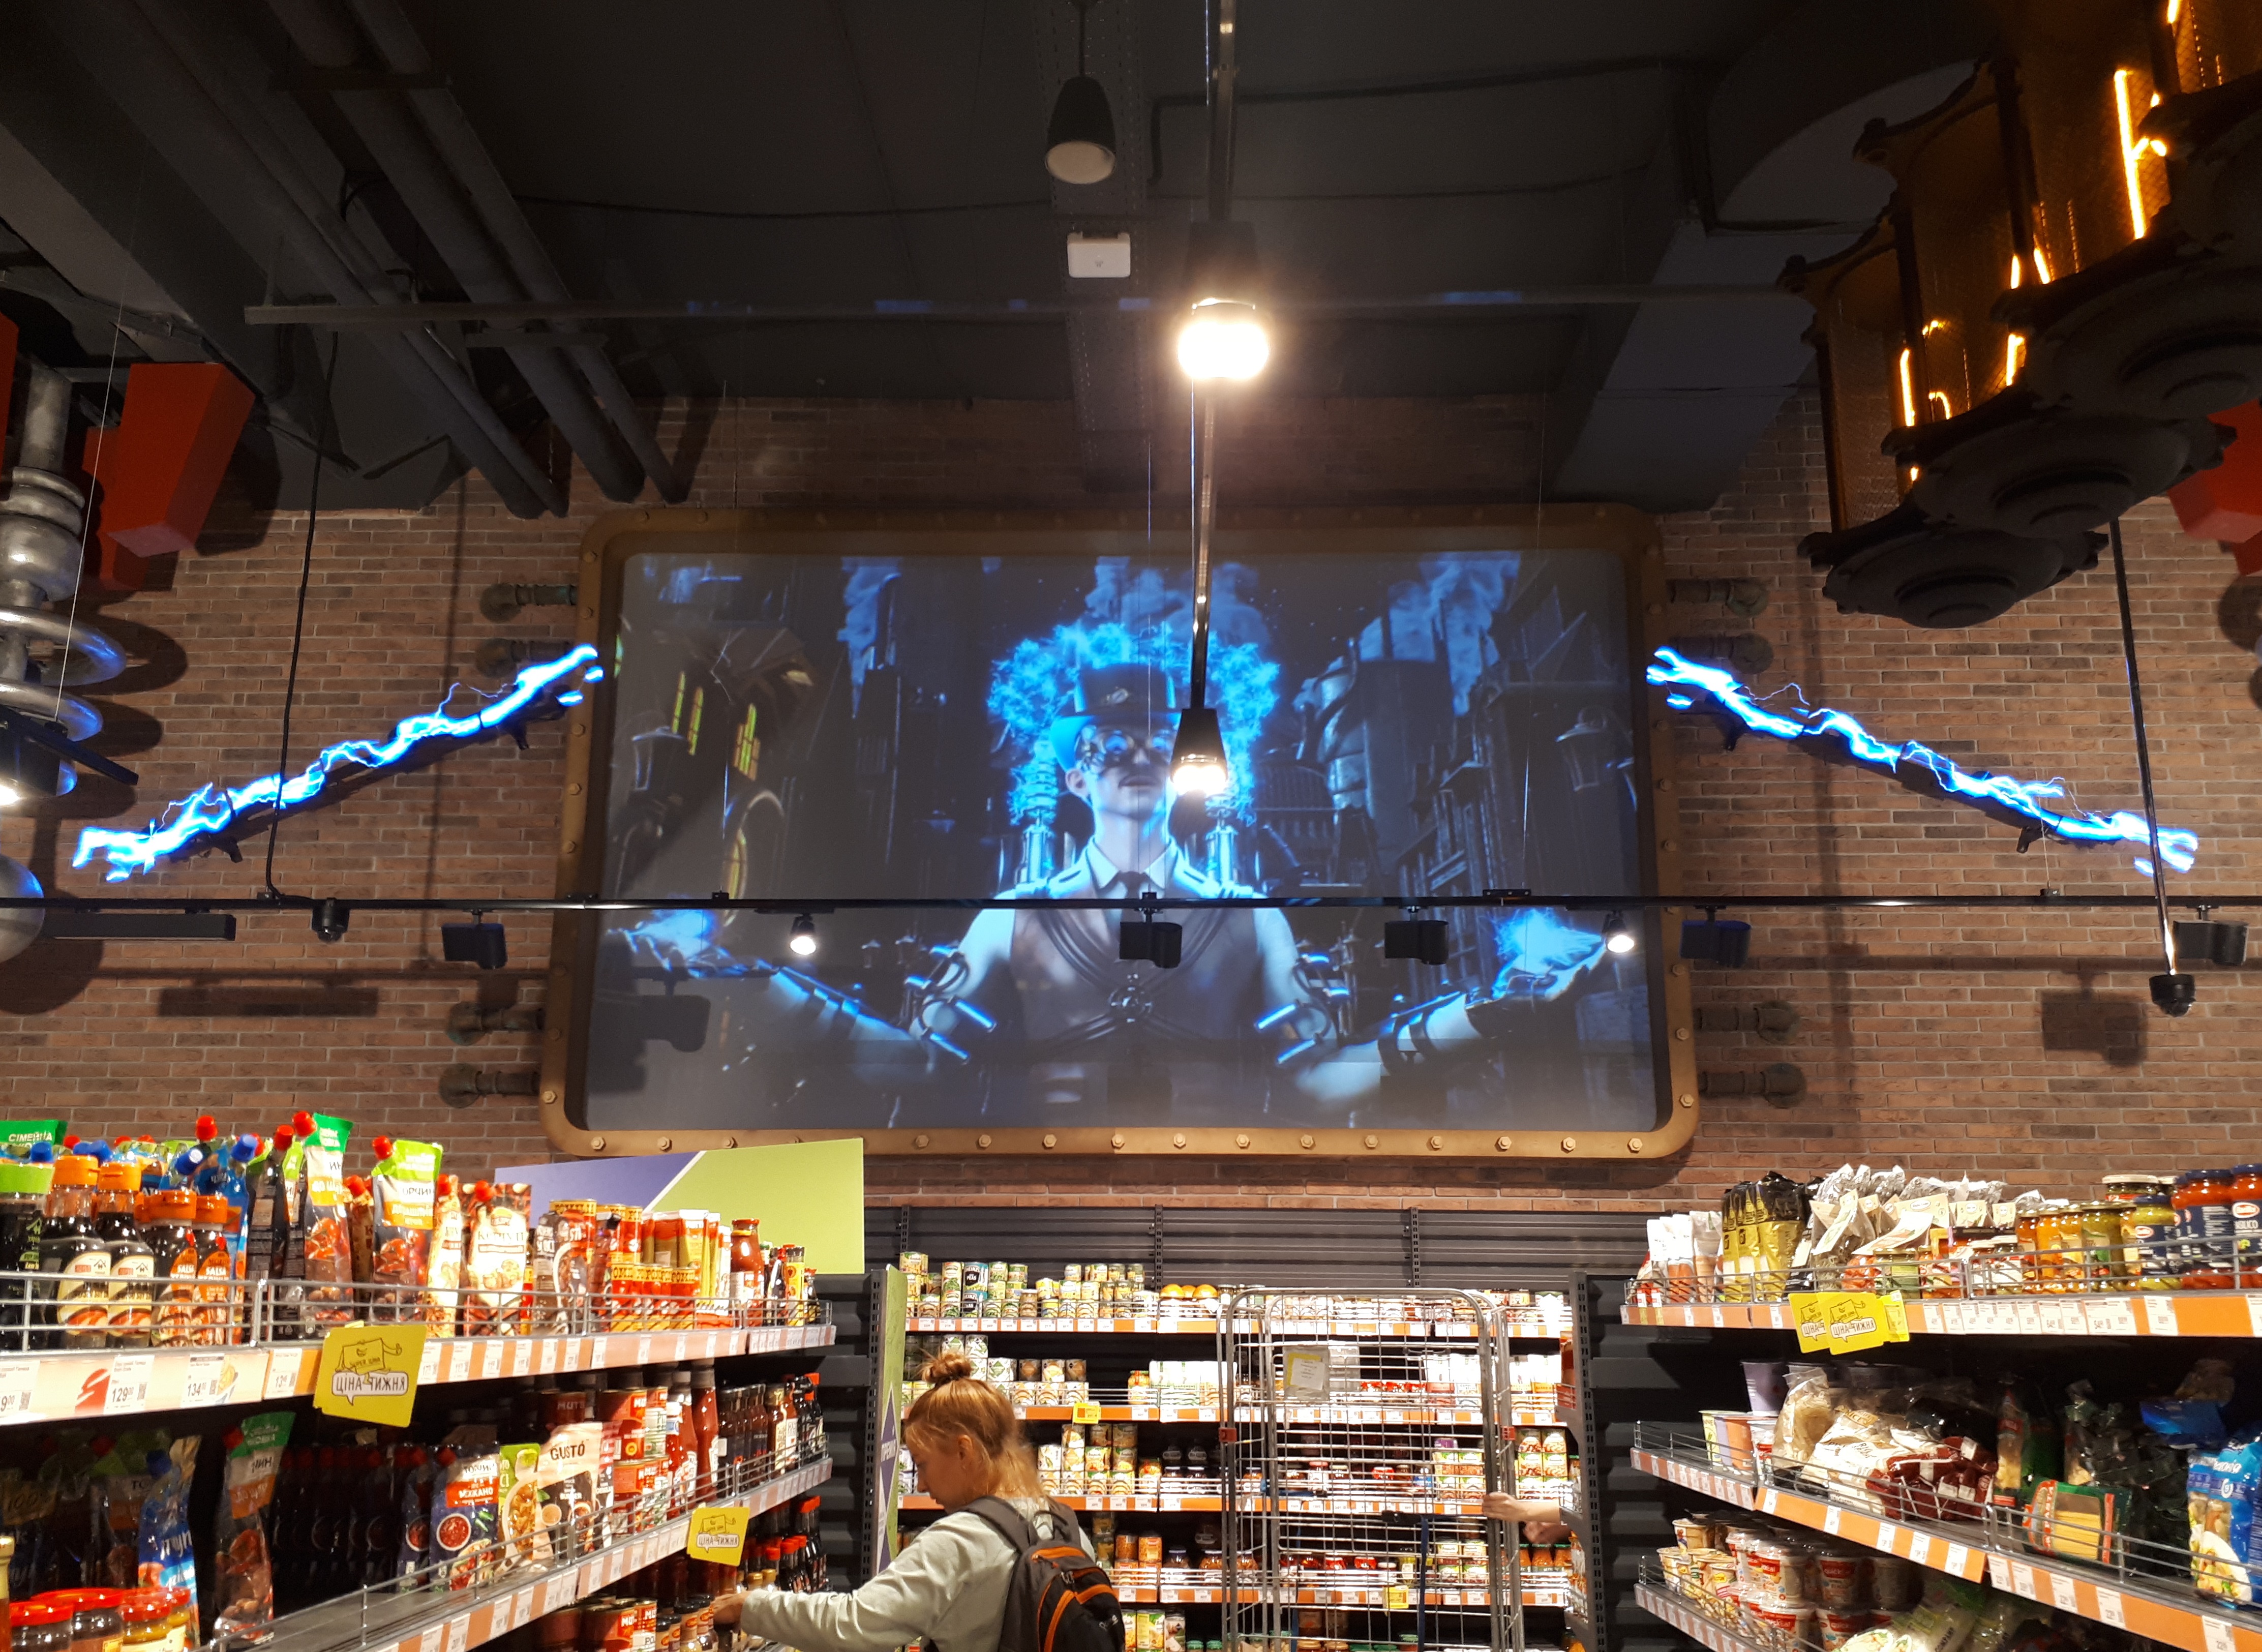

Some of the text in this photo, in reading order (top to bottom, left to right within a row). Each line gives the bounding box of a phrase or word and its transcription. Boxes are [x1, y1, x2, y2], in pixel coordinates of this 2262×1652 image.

[336, 1373, 405, 1394] ЦІНА ТИЖНЯ
[550, 1440, 585, 1461] GUSTÓ
[699, 1536, 738, 1546] ЦІНА ТИЖНЯ
